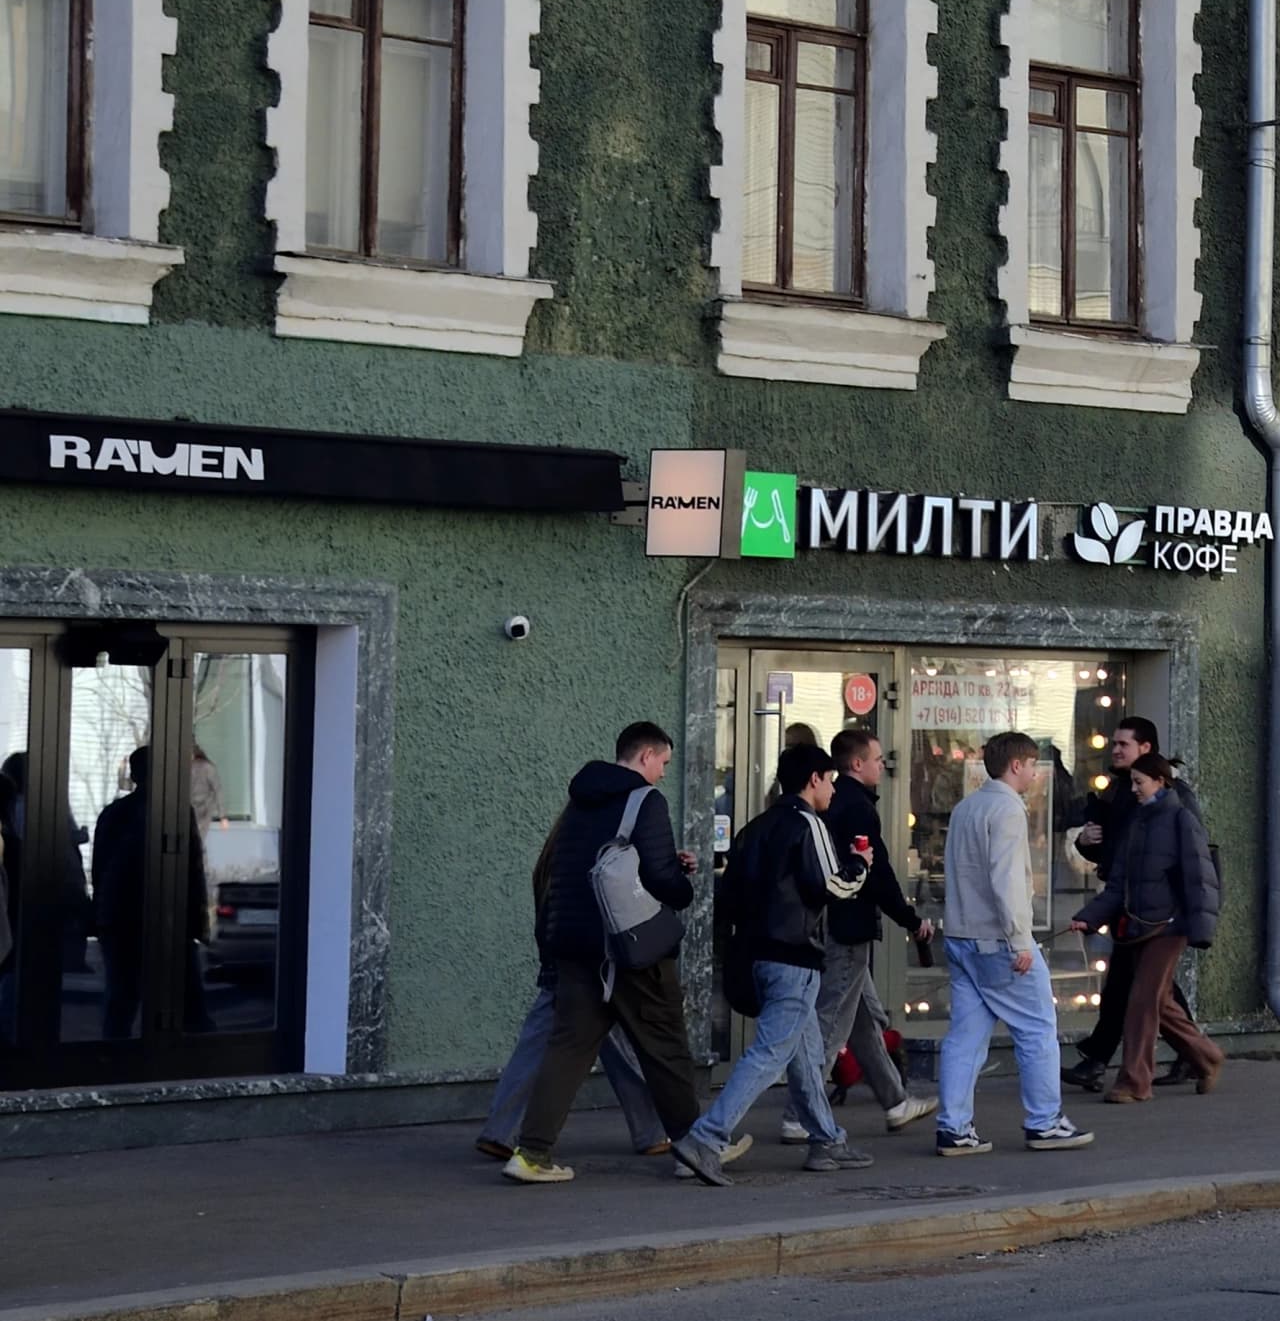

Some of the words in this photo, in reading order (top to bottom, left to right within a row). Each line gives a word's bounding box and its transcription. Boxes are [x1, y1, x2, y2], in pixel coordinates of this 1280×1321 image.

[809, 487, 1038, 560] МИЛТИ
[1155, 505, 1274, 544] ПРАВДА
[1153, 541, 1238, 573] КОФЕ
[852, 686, 873, 701] 18+
[912, 680, 960, 697] АРЕНДА
